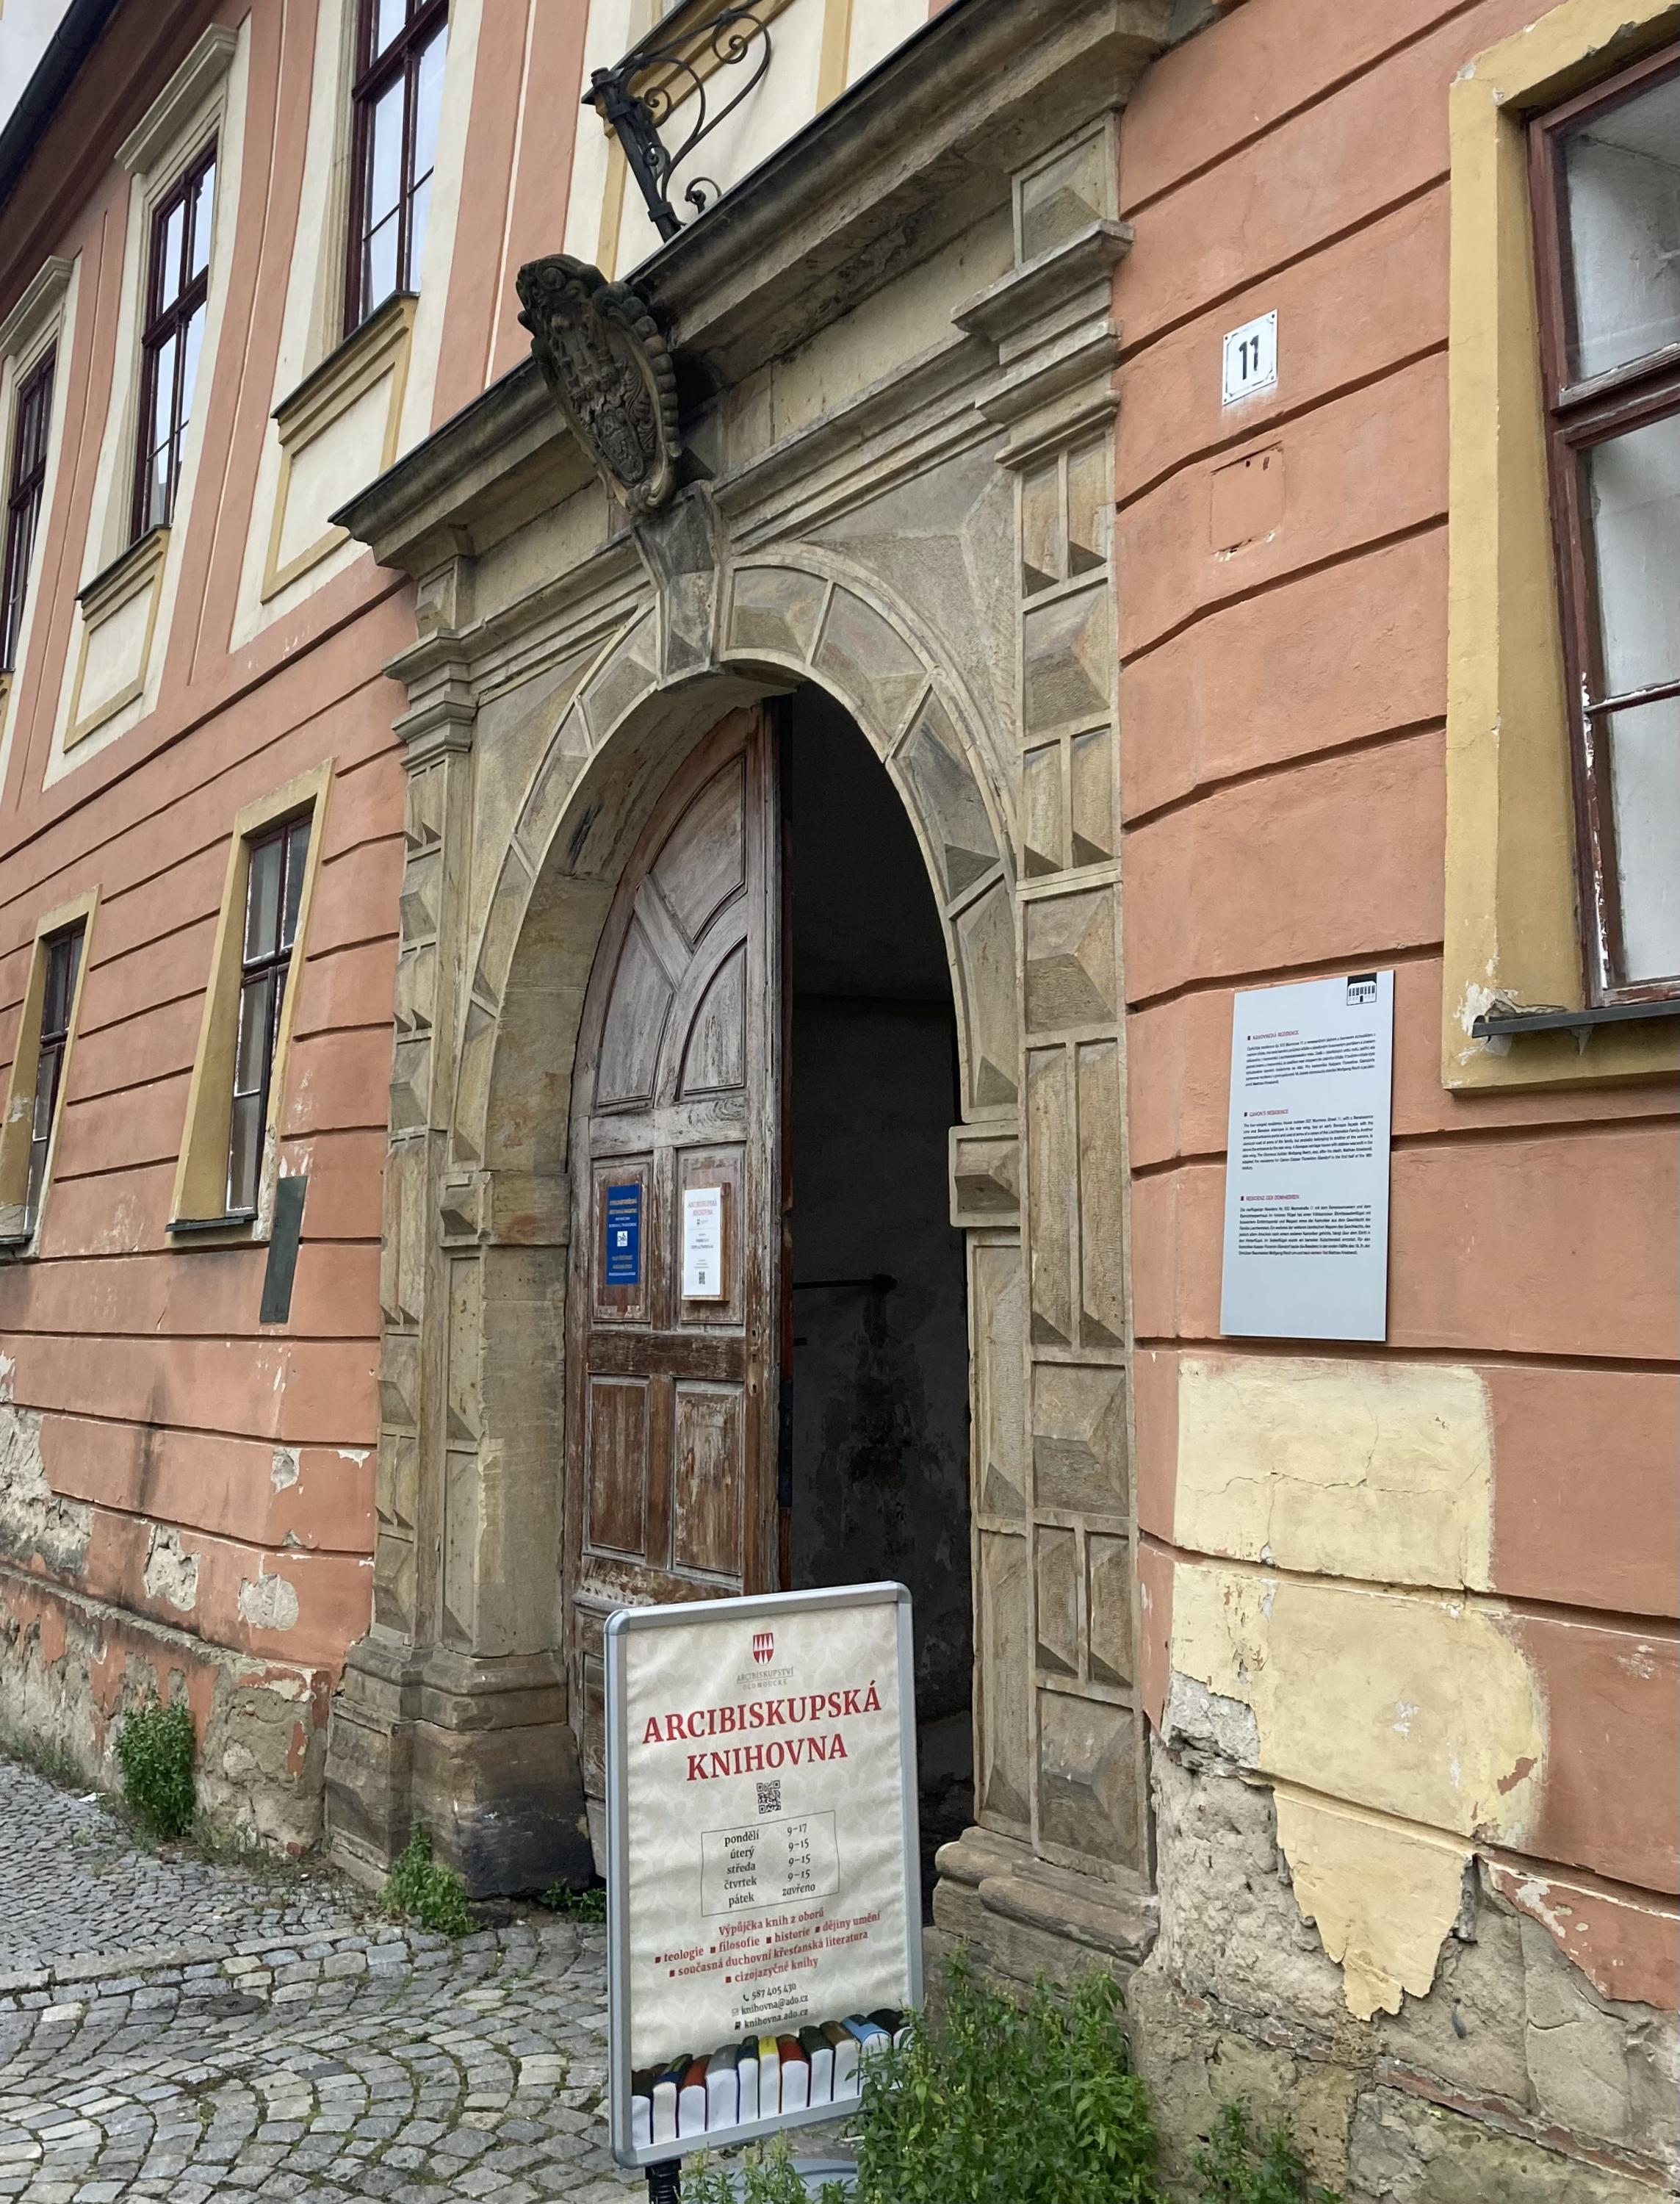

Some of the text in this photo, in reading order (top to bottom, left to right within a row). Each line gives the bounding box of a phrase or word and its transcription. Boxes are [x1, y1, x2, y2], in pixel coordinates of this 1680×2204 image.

[1239, 334, 1259, 380] 11
[642, 1679, 882, 1744] ARCIBISKUPSKÁ
[687, 1733, 848, 1781] KNIHOVNA
[724, 1829, 760, 1847] pondělí
[730, 1845, 754, 1859] úterý
[727, 1861, 756, 1874] středa
[724, 1876, 757, 1890] čtvrtek
[728, 1883, 815, 1908] pátek zavřeno
[718, 1906, 824, 1937] Výpůjčka knih z oborů
[664, 1910, 881, 1962] teologie filosofie historie dějiny umění
[678, 1931, 868, 1976] současná duchovní křesťanská literatura
[735, 1956, 818, 1982] cizojazyčné knihy
[751, 1983, 797, 2000] 587 405 430
[741, 1995, 809, 2015] knihovna@ado.cz
[744, 2009, 809, 2028] knihovna.ado.cz
